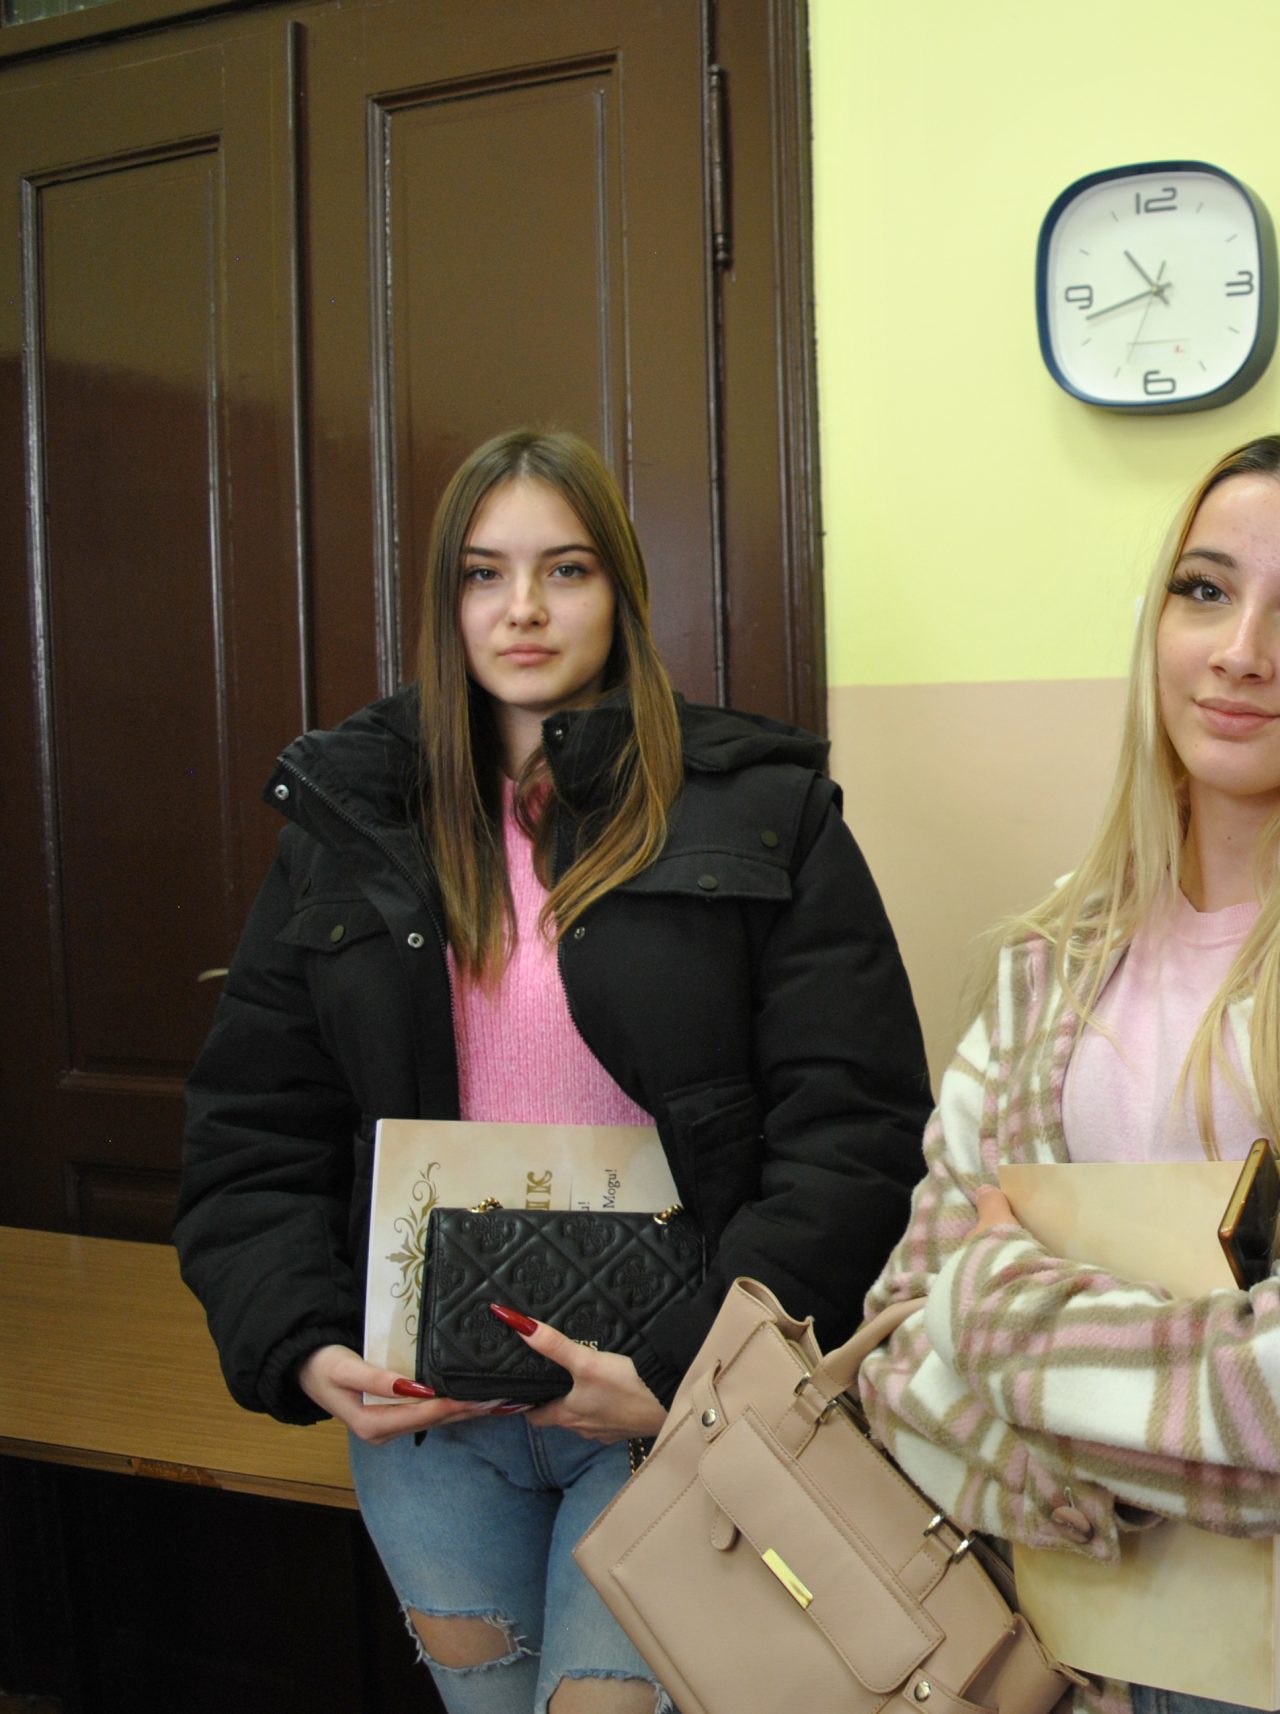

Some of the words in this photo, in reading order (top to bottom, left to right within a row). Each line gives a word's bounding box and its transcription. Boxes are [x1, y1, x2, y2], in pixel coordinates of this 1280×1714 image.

[1135, 187, 1177, 214] 12
[1065, 284, 1093, 310] 9
[1225, 270, 1254, 297] 3
[1143, 370, 1177, 395] 6
[602, 1168, 620, 1209] Mogu!
